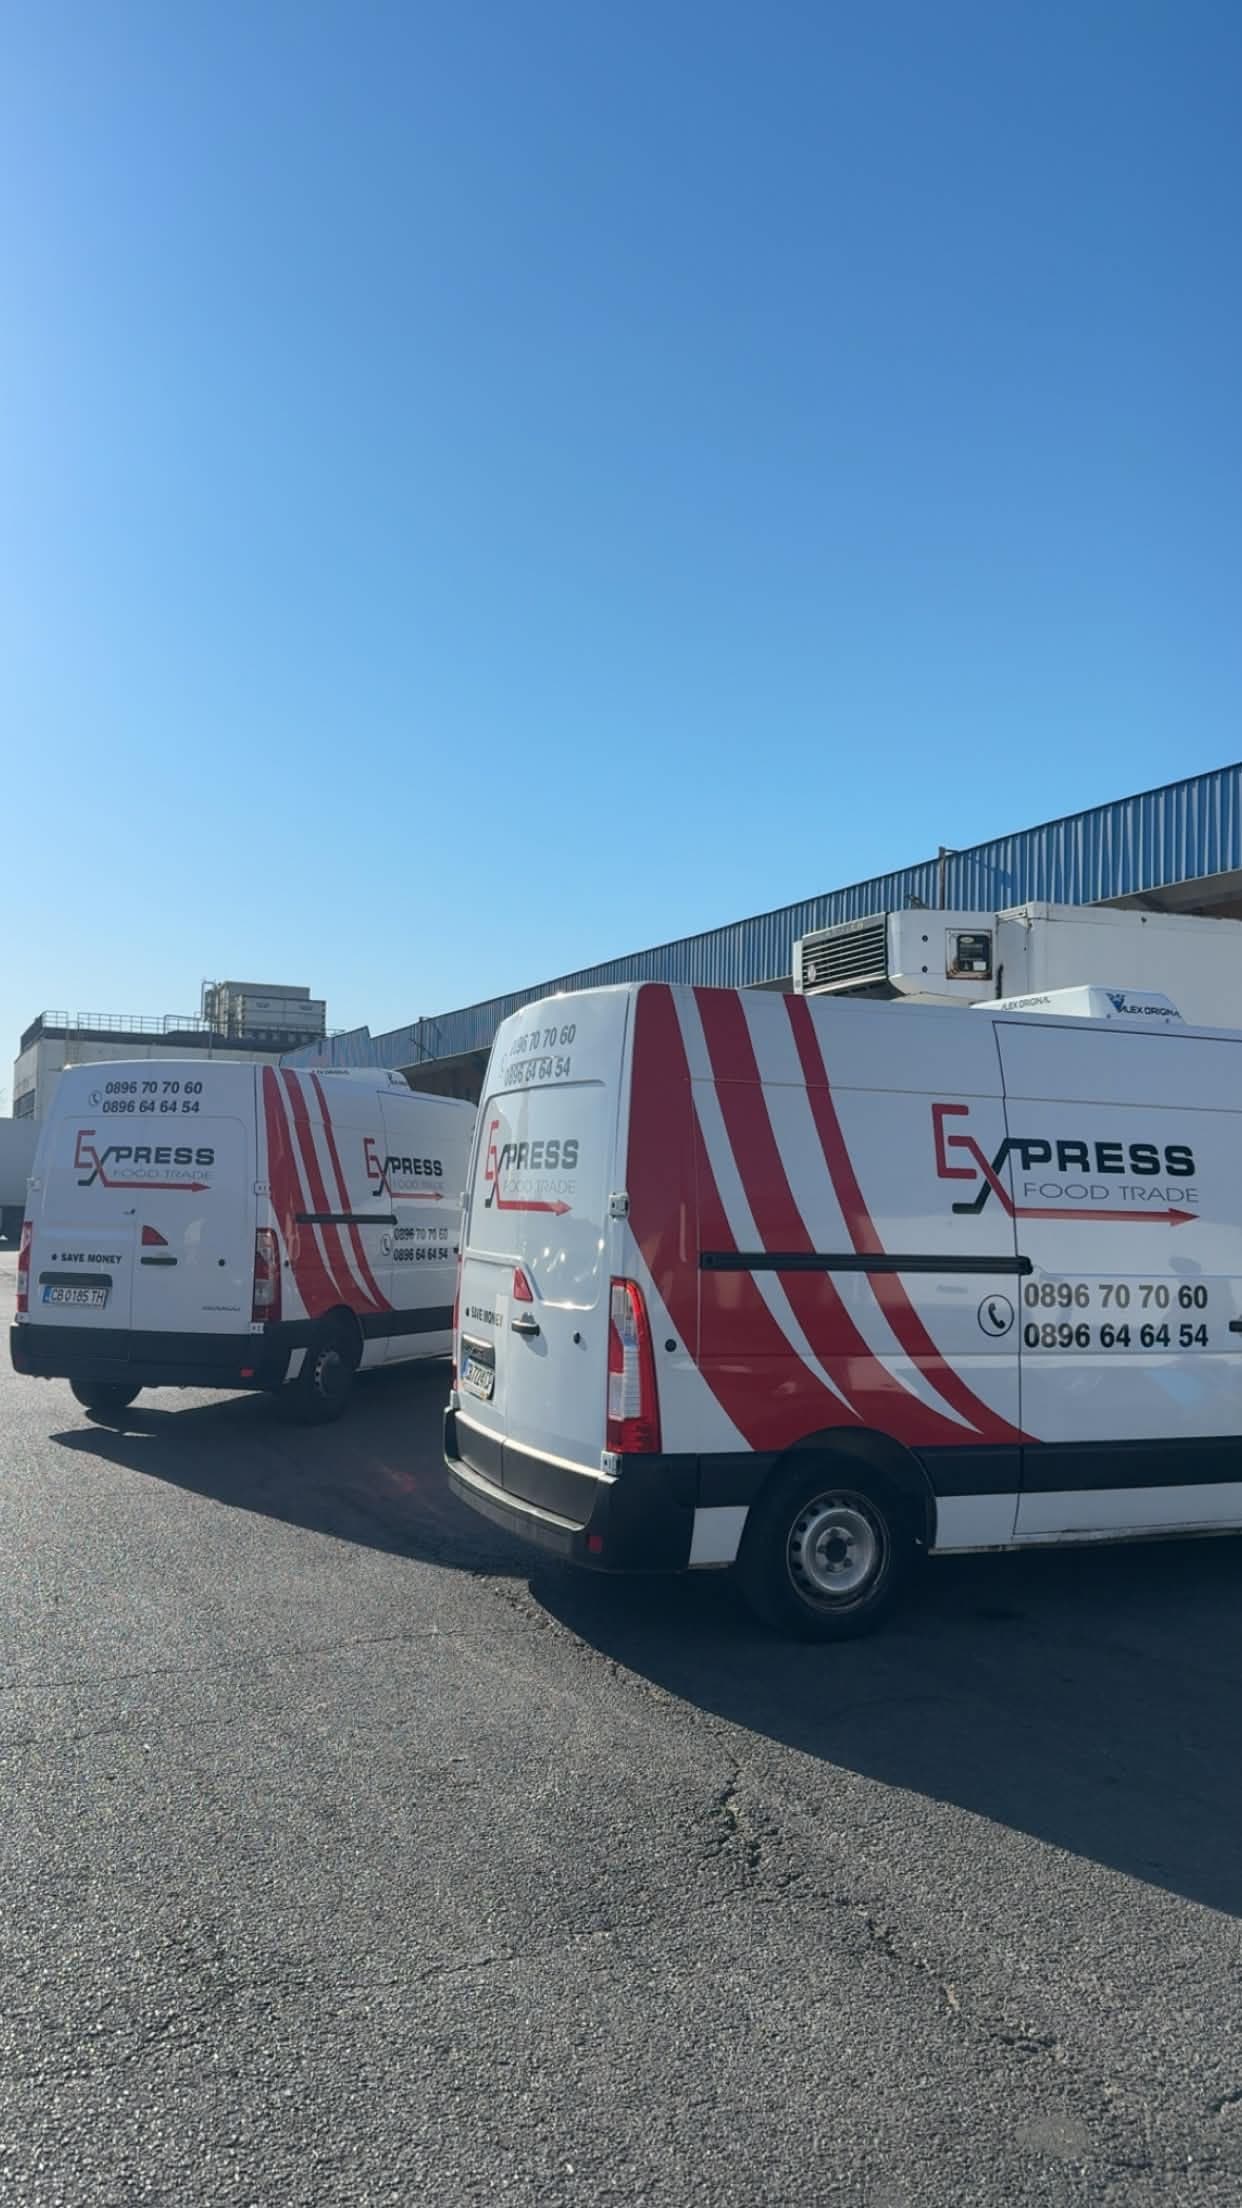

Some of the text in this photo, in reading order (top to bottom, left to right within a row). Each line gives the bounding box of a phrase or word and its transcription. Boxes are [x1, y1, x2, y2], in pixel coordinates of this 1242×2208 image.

[529, 1029, 540, 1051] 70
[543, 1026, 557, 1049] 70
[560, 1024, 576, 1045] 60
[539, 1058, 552, 1080] 64
[554, 1056, 571, 1078] 54
[105, 1081, 203, 1094] 0896 70 70 60
[102, 1101, 200, 1113] 0896 64 64 54
[74, 1130, 215, 1186] EXPRESS
[363, 1138, 443, 1196] EXPRESS
[932, 1104, 1196, 1214] EXPRESS
[1024, 1183, 1198, 1202] FOOD TRADE
[61, 1253, 122, 1264] SAVE MONEY
[416, 1248, 426, 1261] 64
[427, 1248, 437, 1260] 64
[1024, 1283, 1208, 1309] 0896 70 70 60
[1024, 1324, 1209, 1347] 0896 64 64 54
